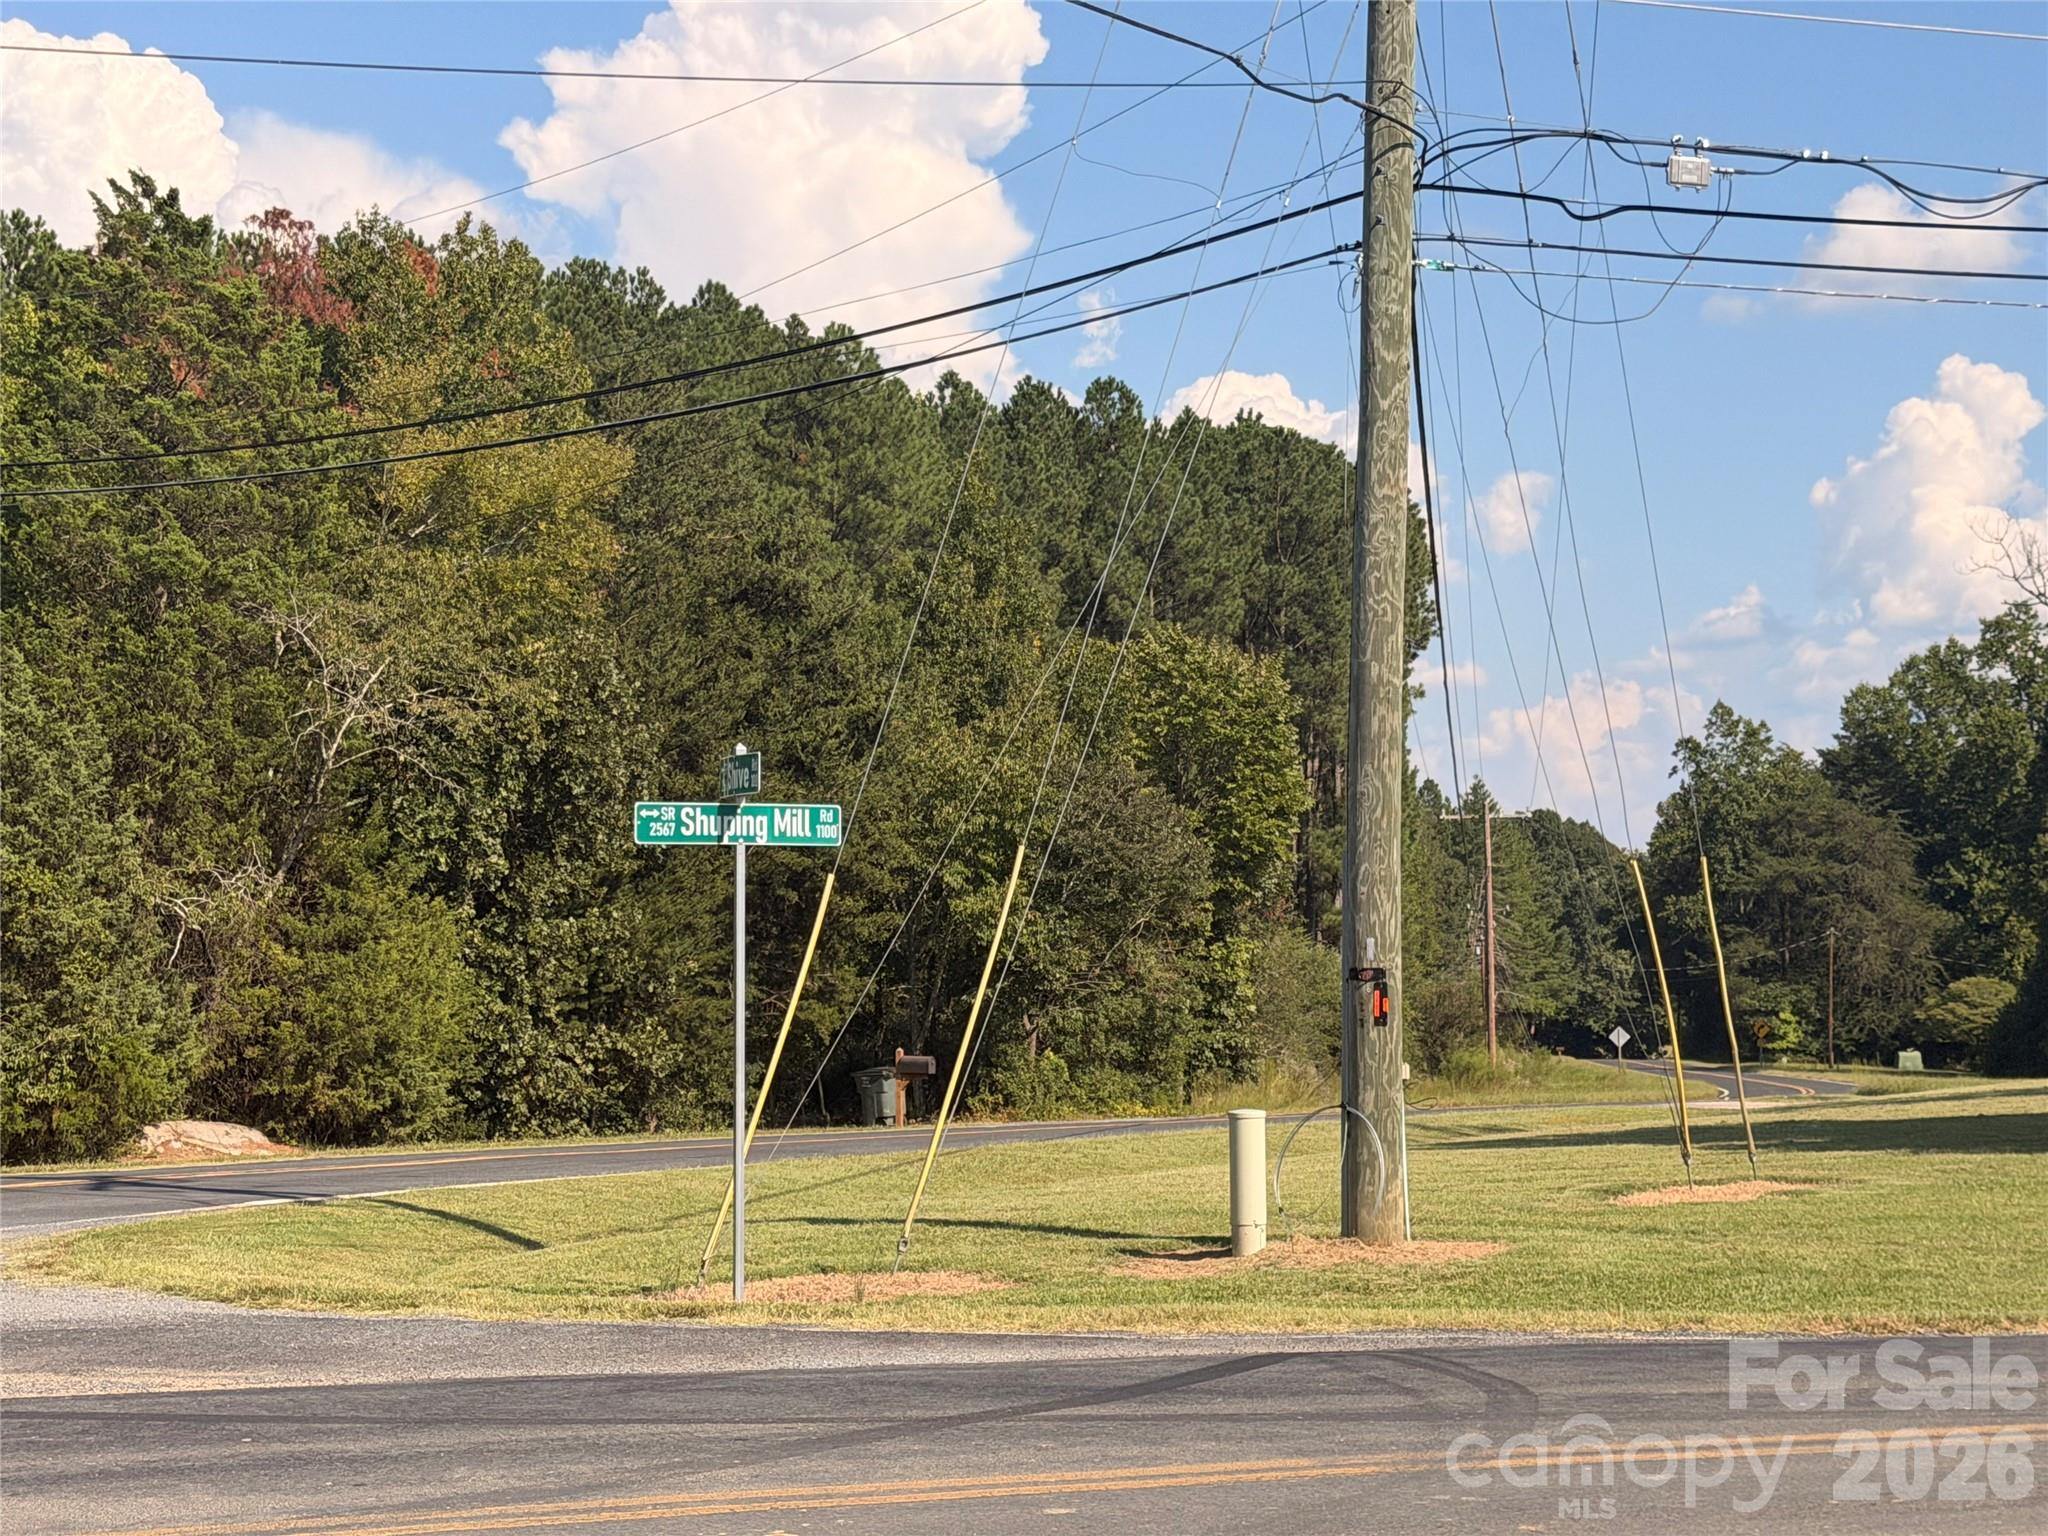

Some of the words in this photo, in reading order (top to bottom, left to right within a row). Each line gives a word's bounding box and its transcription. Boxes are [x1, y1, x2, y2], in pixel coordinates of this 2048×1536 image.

[661, 807, 676, 820] SR
[820, 809, 833, 822] Rd
[649, 822, 675, 836] 2567
[681, 807, 768, 843] Shuping
[774, 808, 811, 837] Mill
[816, 824, 837, 838] 1100
